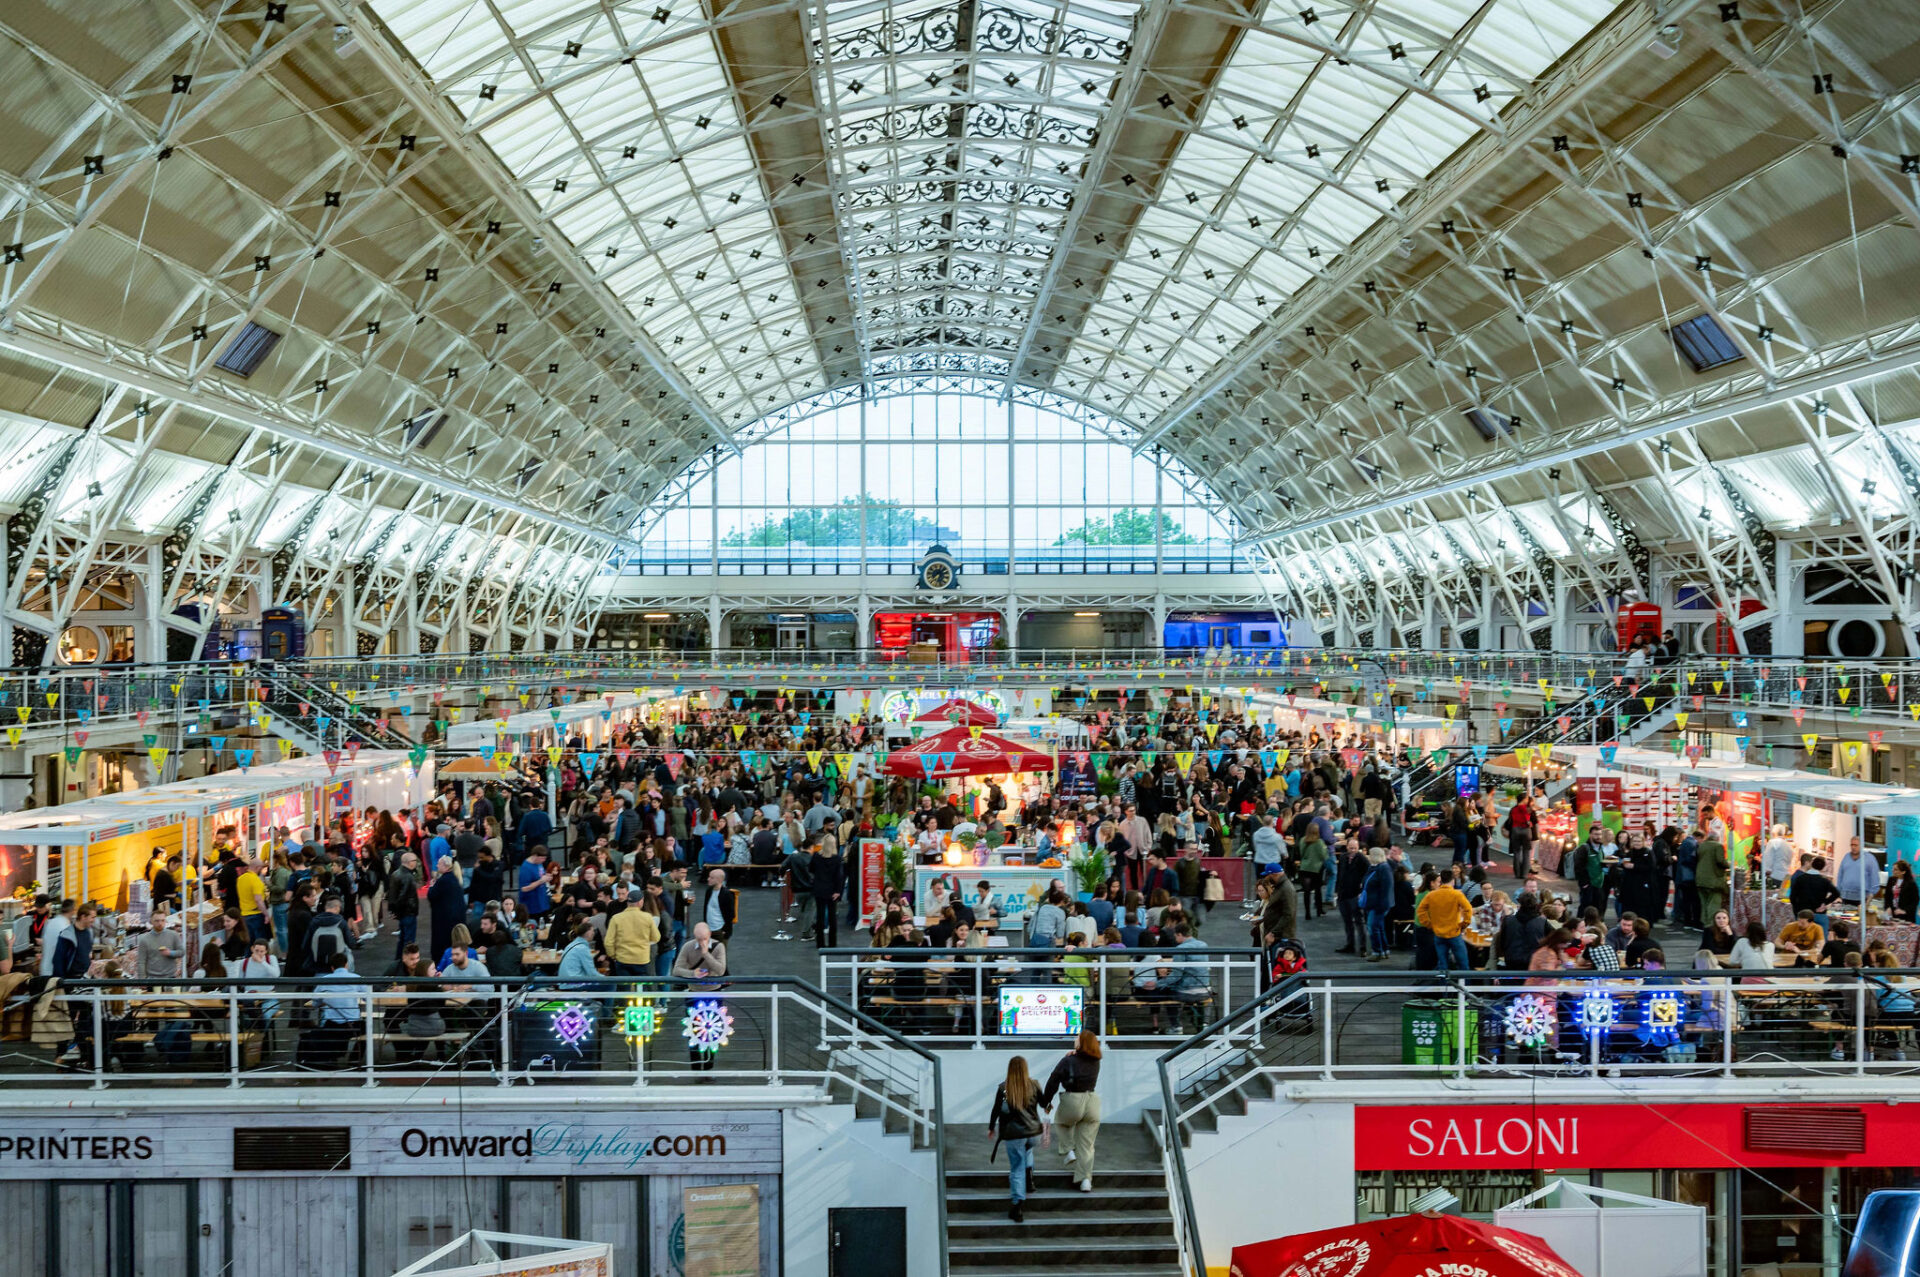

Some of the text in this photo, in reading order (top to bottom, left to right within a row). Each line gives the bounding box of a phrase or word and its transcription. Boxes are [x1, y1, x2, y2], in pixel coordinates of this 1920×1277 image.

[1007, 893, 1026, 904] AT
[0, 1136, 152, 1160] PRINTERS
[1408, 1117, 1578, 1157] SALONI
[1303, 1238, 1360, 1261] BIRRA
